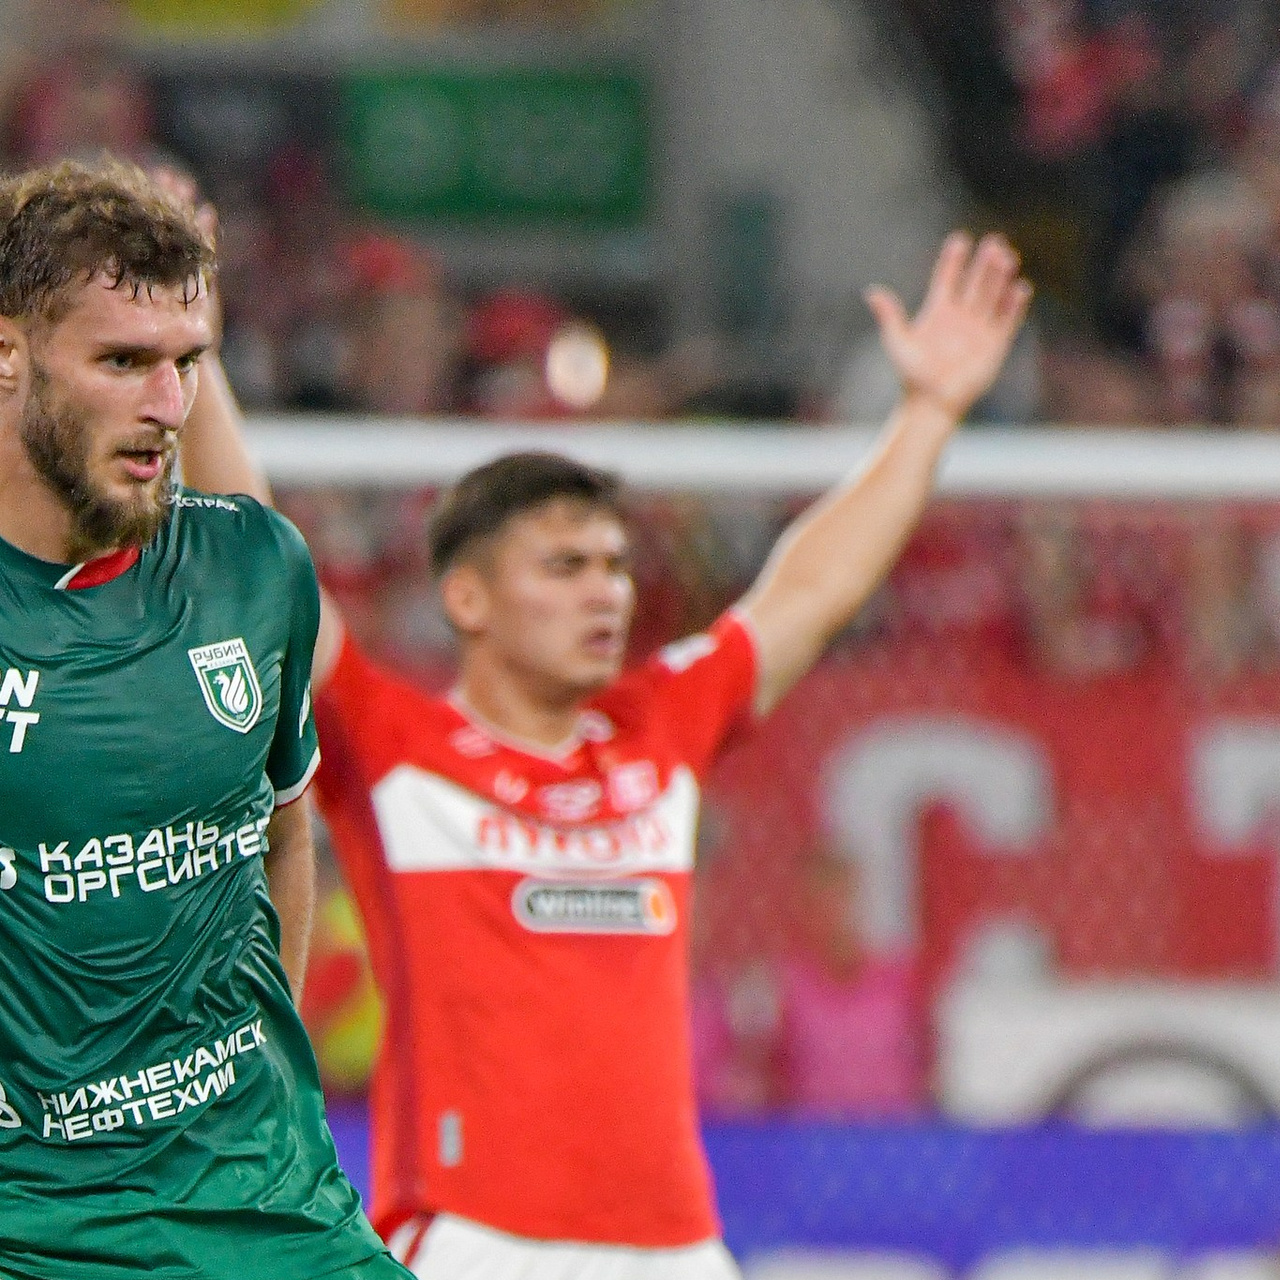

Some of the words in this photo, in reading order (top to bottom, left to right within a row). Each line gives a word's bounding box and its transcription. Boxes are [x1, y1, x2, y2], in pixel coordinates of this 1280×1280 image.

[193, 643, 243, 664] РУБИН
[38, 821, 219, 873] КАЗАНЬ
[37, 1019, 268, 1116] НИЖНЕКАМСК
[42, 1061, 236, 1142] НЕФТЕХИМ
